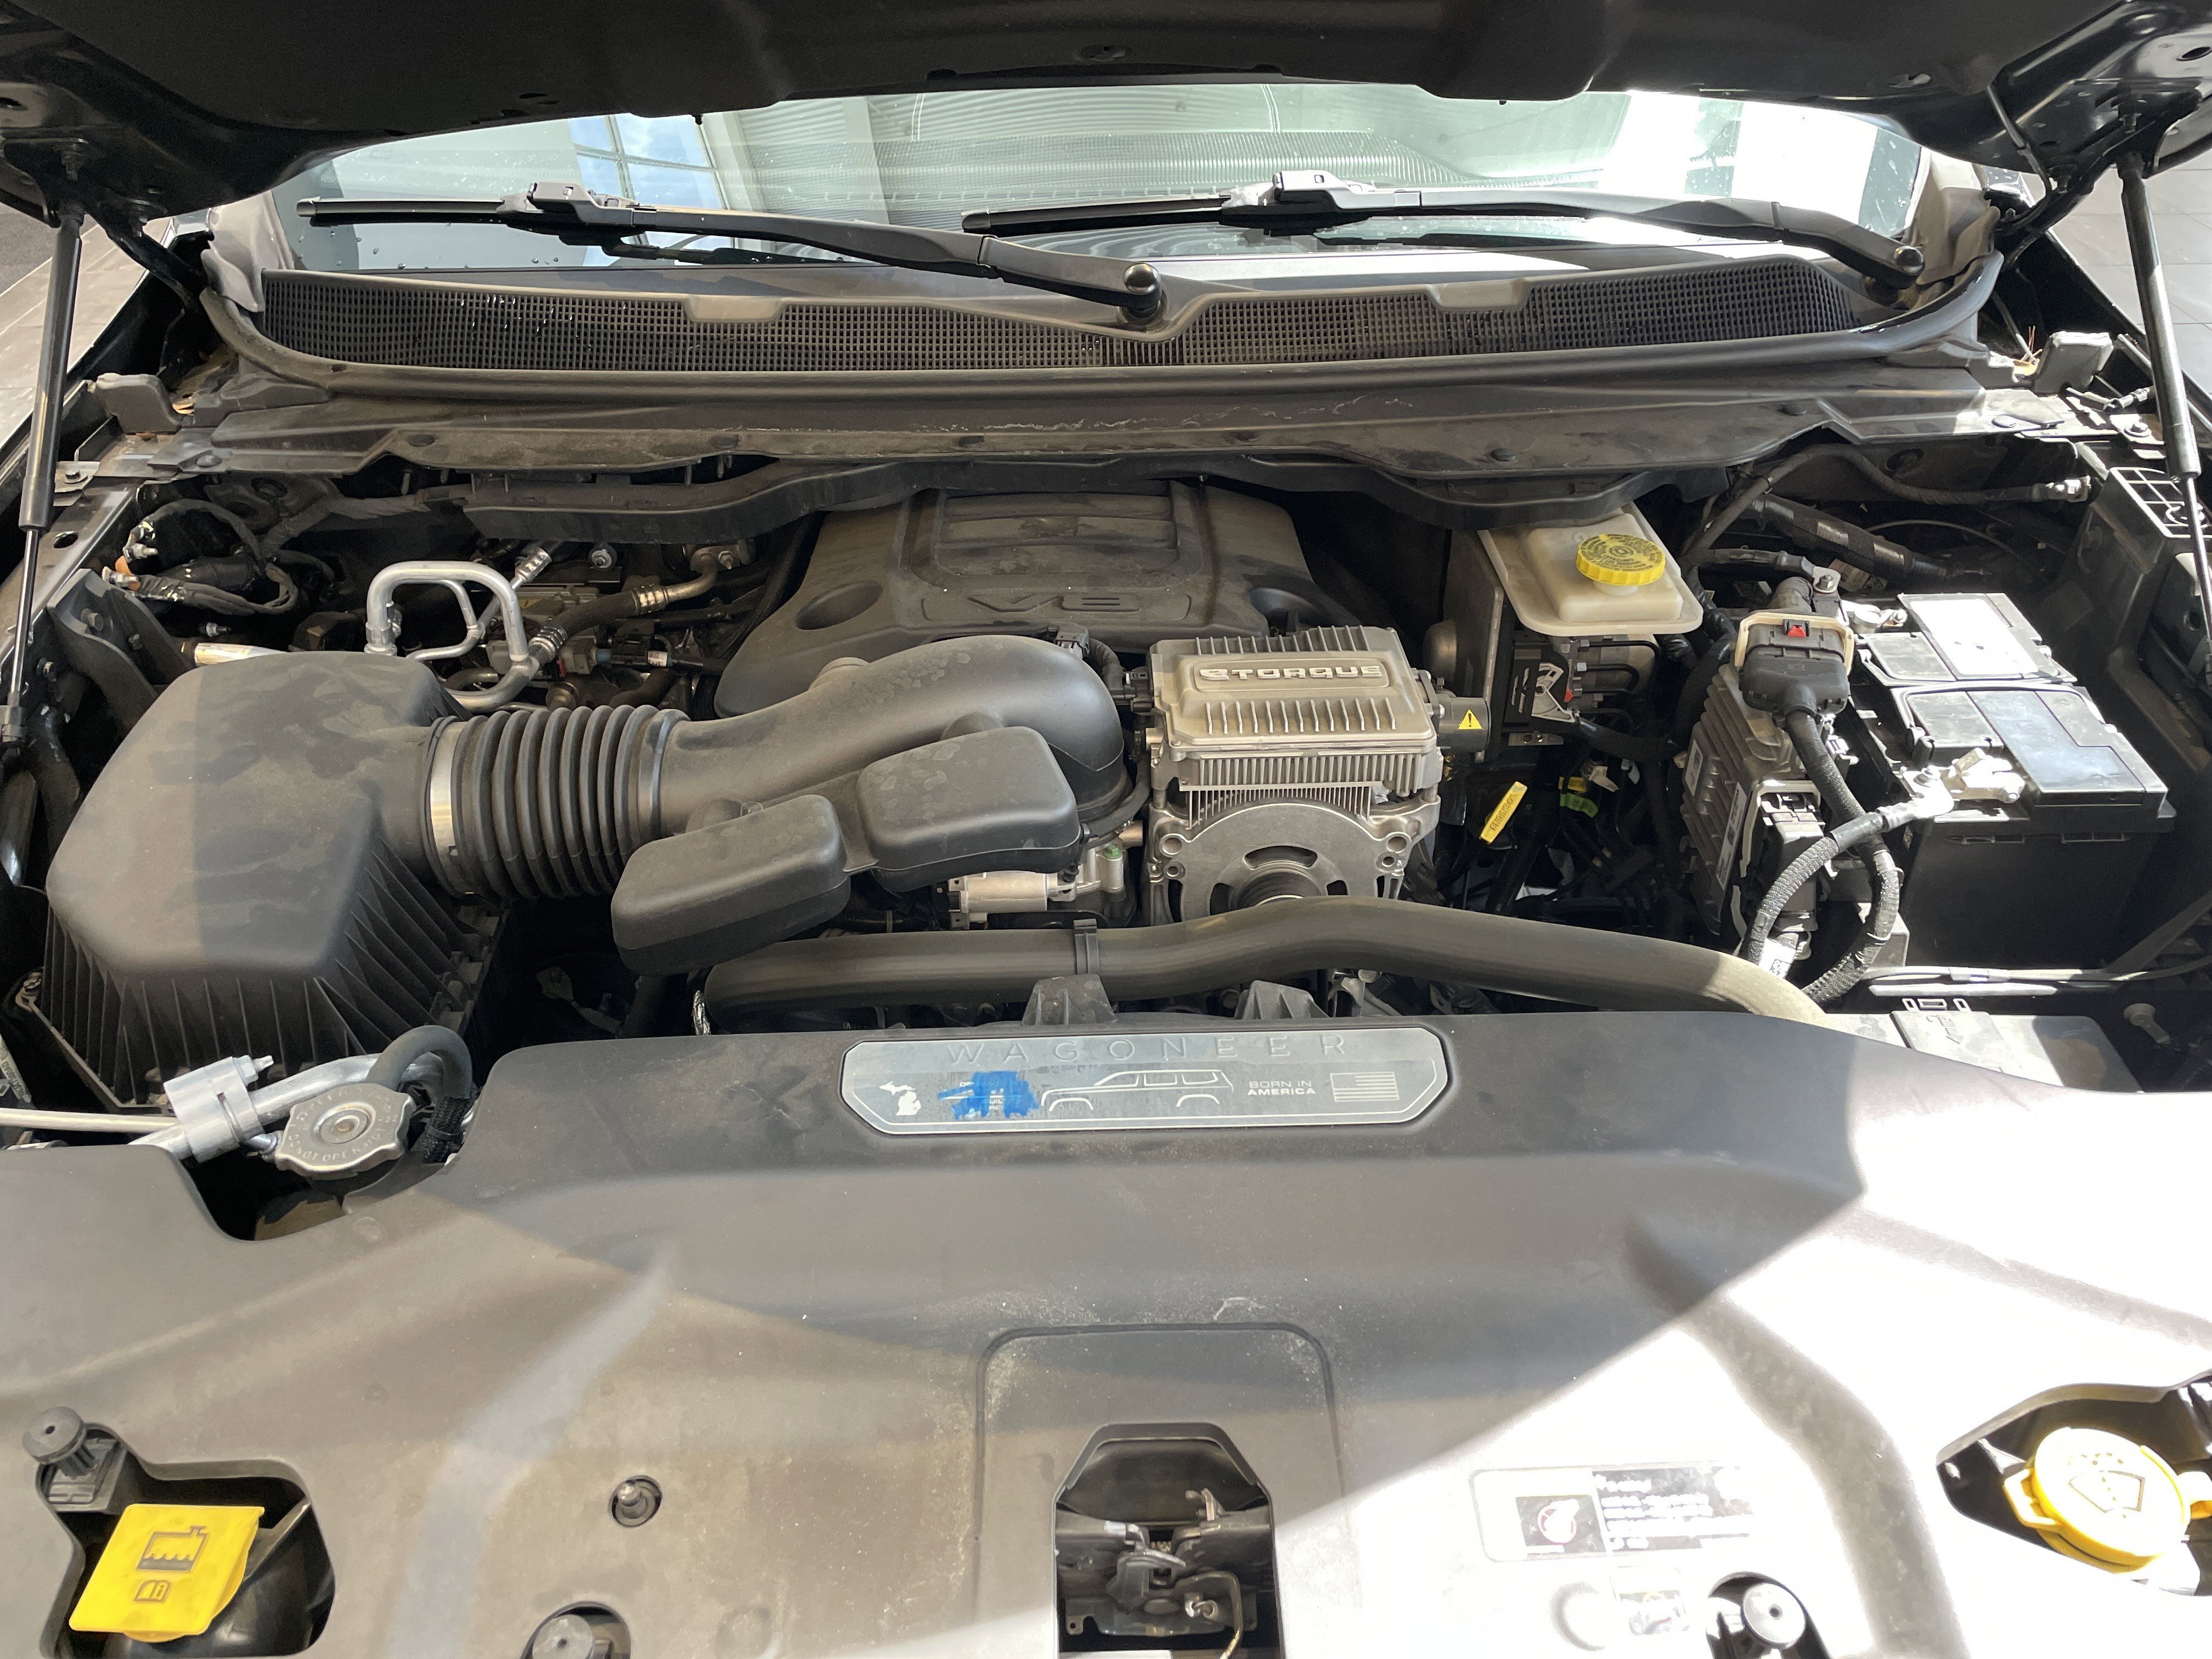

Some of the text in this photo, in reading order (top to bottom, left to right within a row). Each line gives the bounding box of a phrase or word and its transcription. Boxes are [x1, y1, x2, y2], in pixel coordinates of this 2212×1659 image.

[1489, 793, 1518, 831] ENGINE OIL
[947, 1034, 1345, 1065] WAGONEER
[1248, 1088, 1316, 1096] AMERICA
